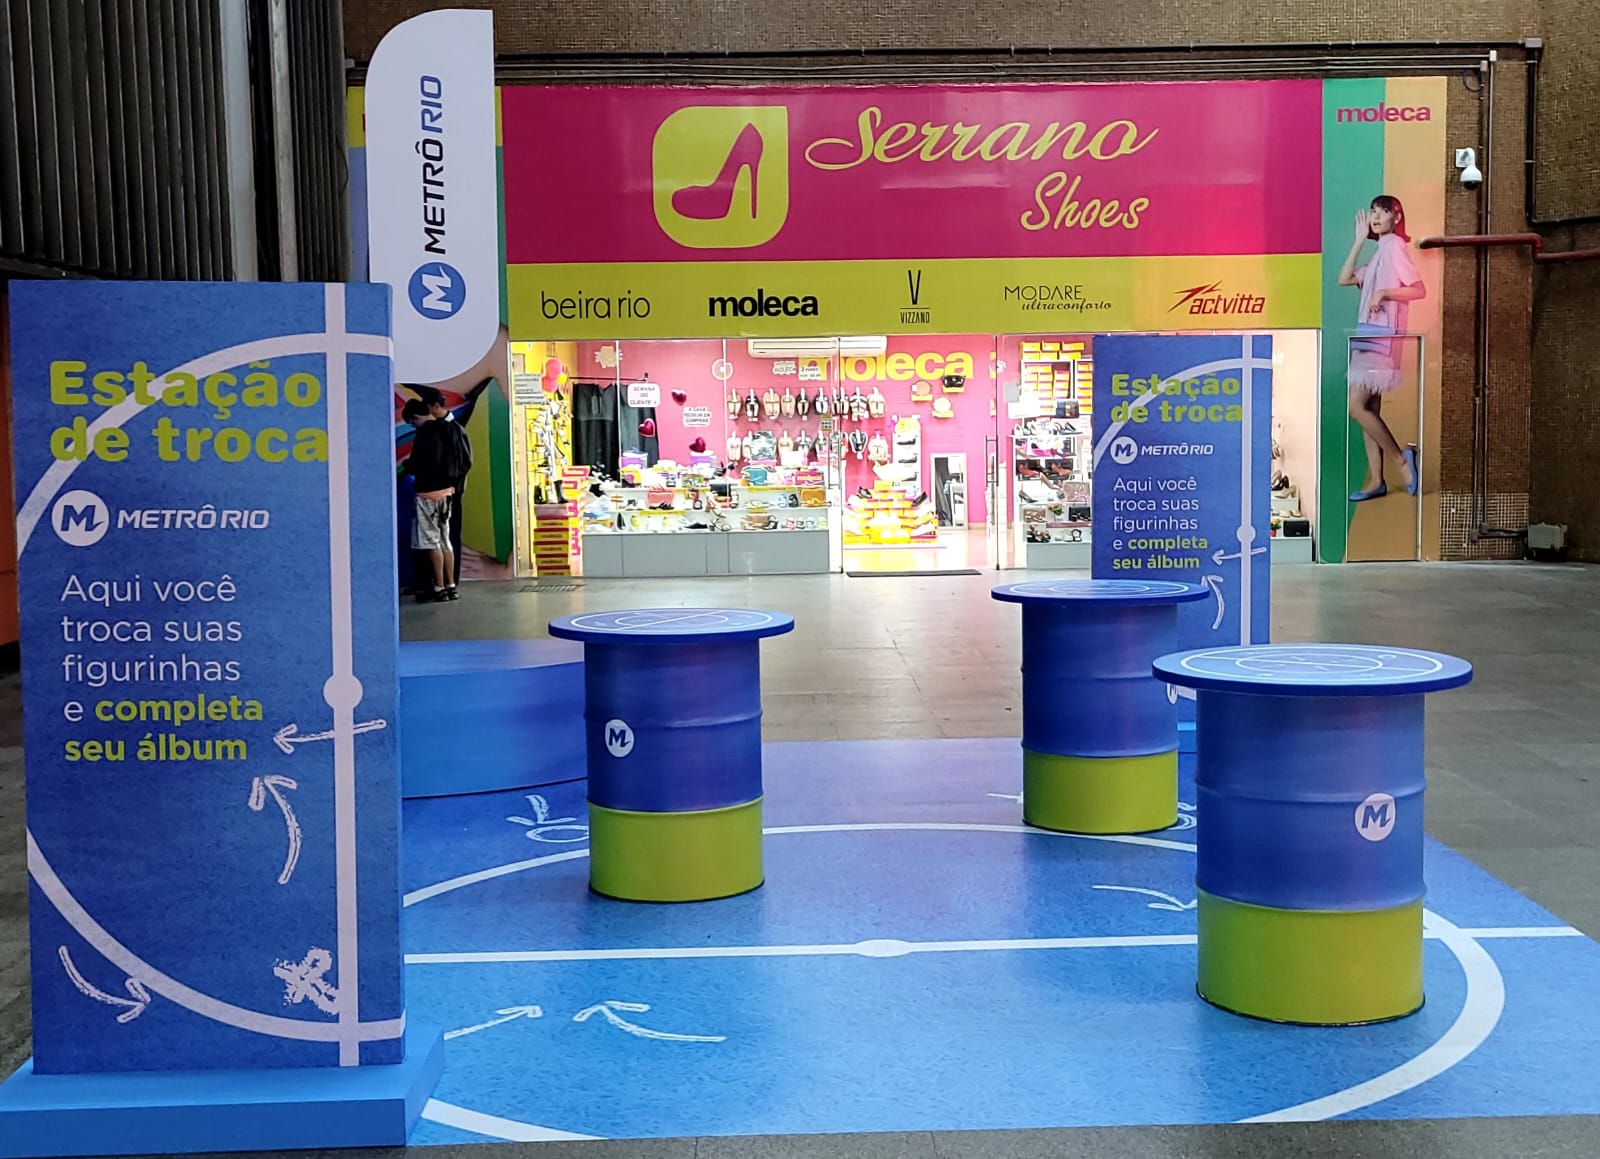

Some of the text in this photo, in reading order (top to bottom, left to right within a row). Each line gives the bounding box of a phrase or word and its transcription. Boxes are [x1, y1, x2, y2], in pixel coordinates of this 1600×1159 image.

[1336, 102, 1431, 123] moleca
[805, 106, 1159, 170] Serrano
[1020, 171, 1149, 231] Shoes
[541, 290, 651, 319] beira rio
[708, 288, 819, 317] moleca
[1004, 284, 1083, 301] MODARE
[1021, 297, 1112, 314] ultraconforto
[899, 311, 930, 324] VIZZANO
[49, 360, 321, 420] Estação
[1111, 372, 1240, 400] Estação
[1111, 402, 1242, 423] de troca
[50, 416, 329, 462] de troca
[1113, 476, 1198, 493] Aqui você
[1113, 497, 1199, 511] troca suas
[1113, 516, 1198, 533] figurinhas
[1113, 535, 1208, 551] e completa
[1113, 553, 1200, 569] seu álbum
[61, 574, 237, 606] Aqui você
[61, 614, 242, 642] troca suas
[62, 654, 241, 688] figurinhas
[63, 694, 263, 727] e completa
[64, 733, 248, 761] seu álbum
